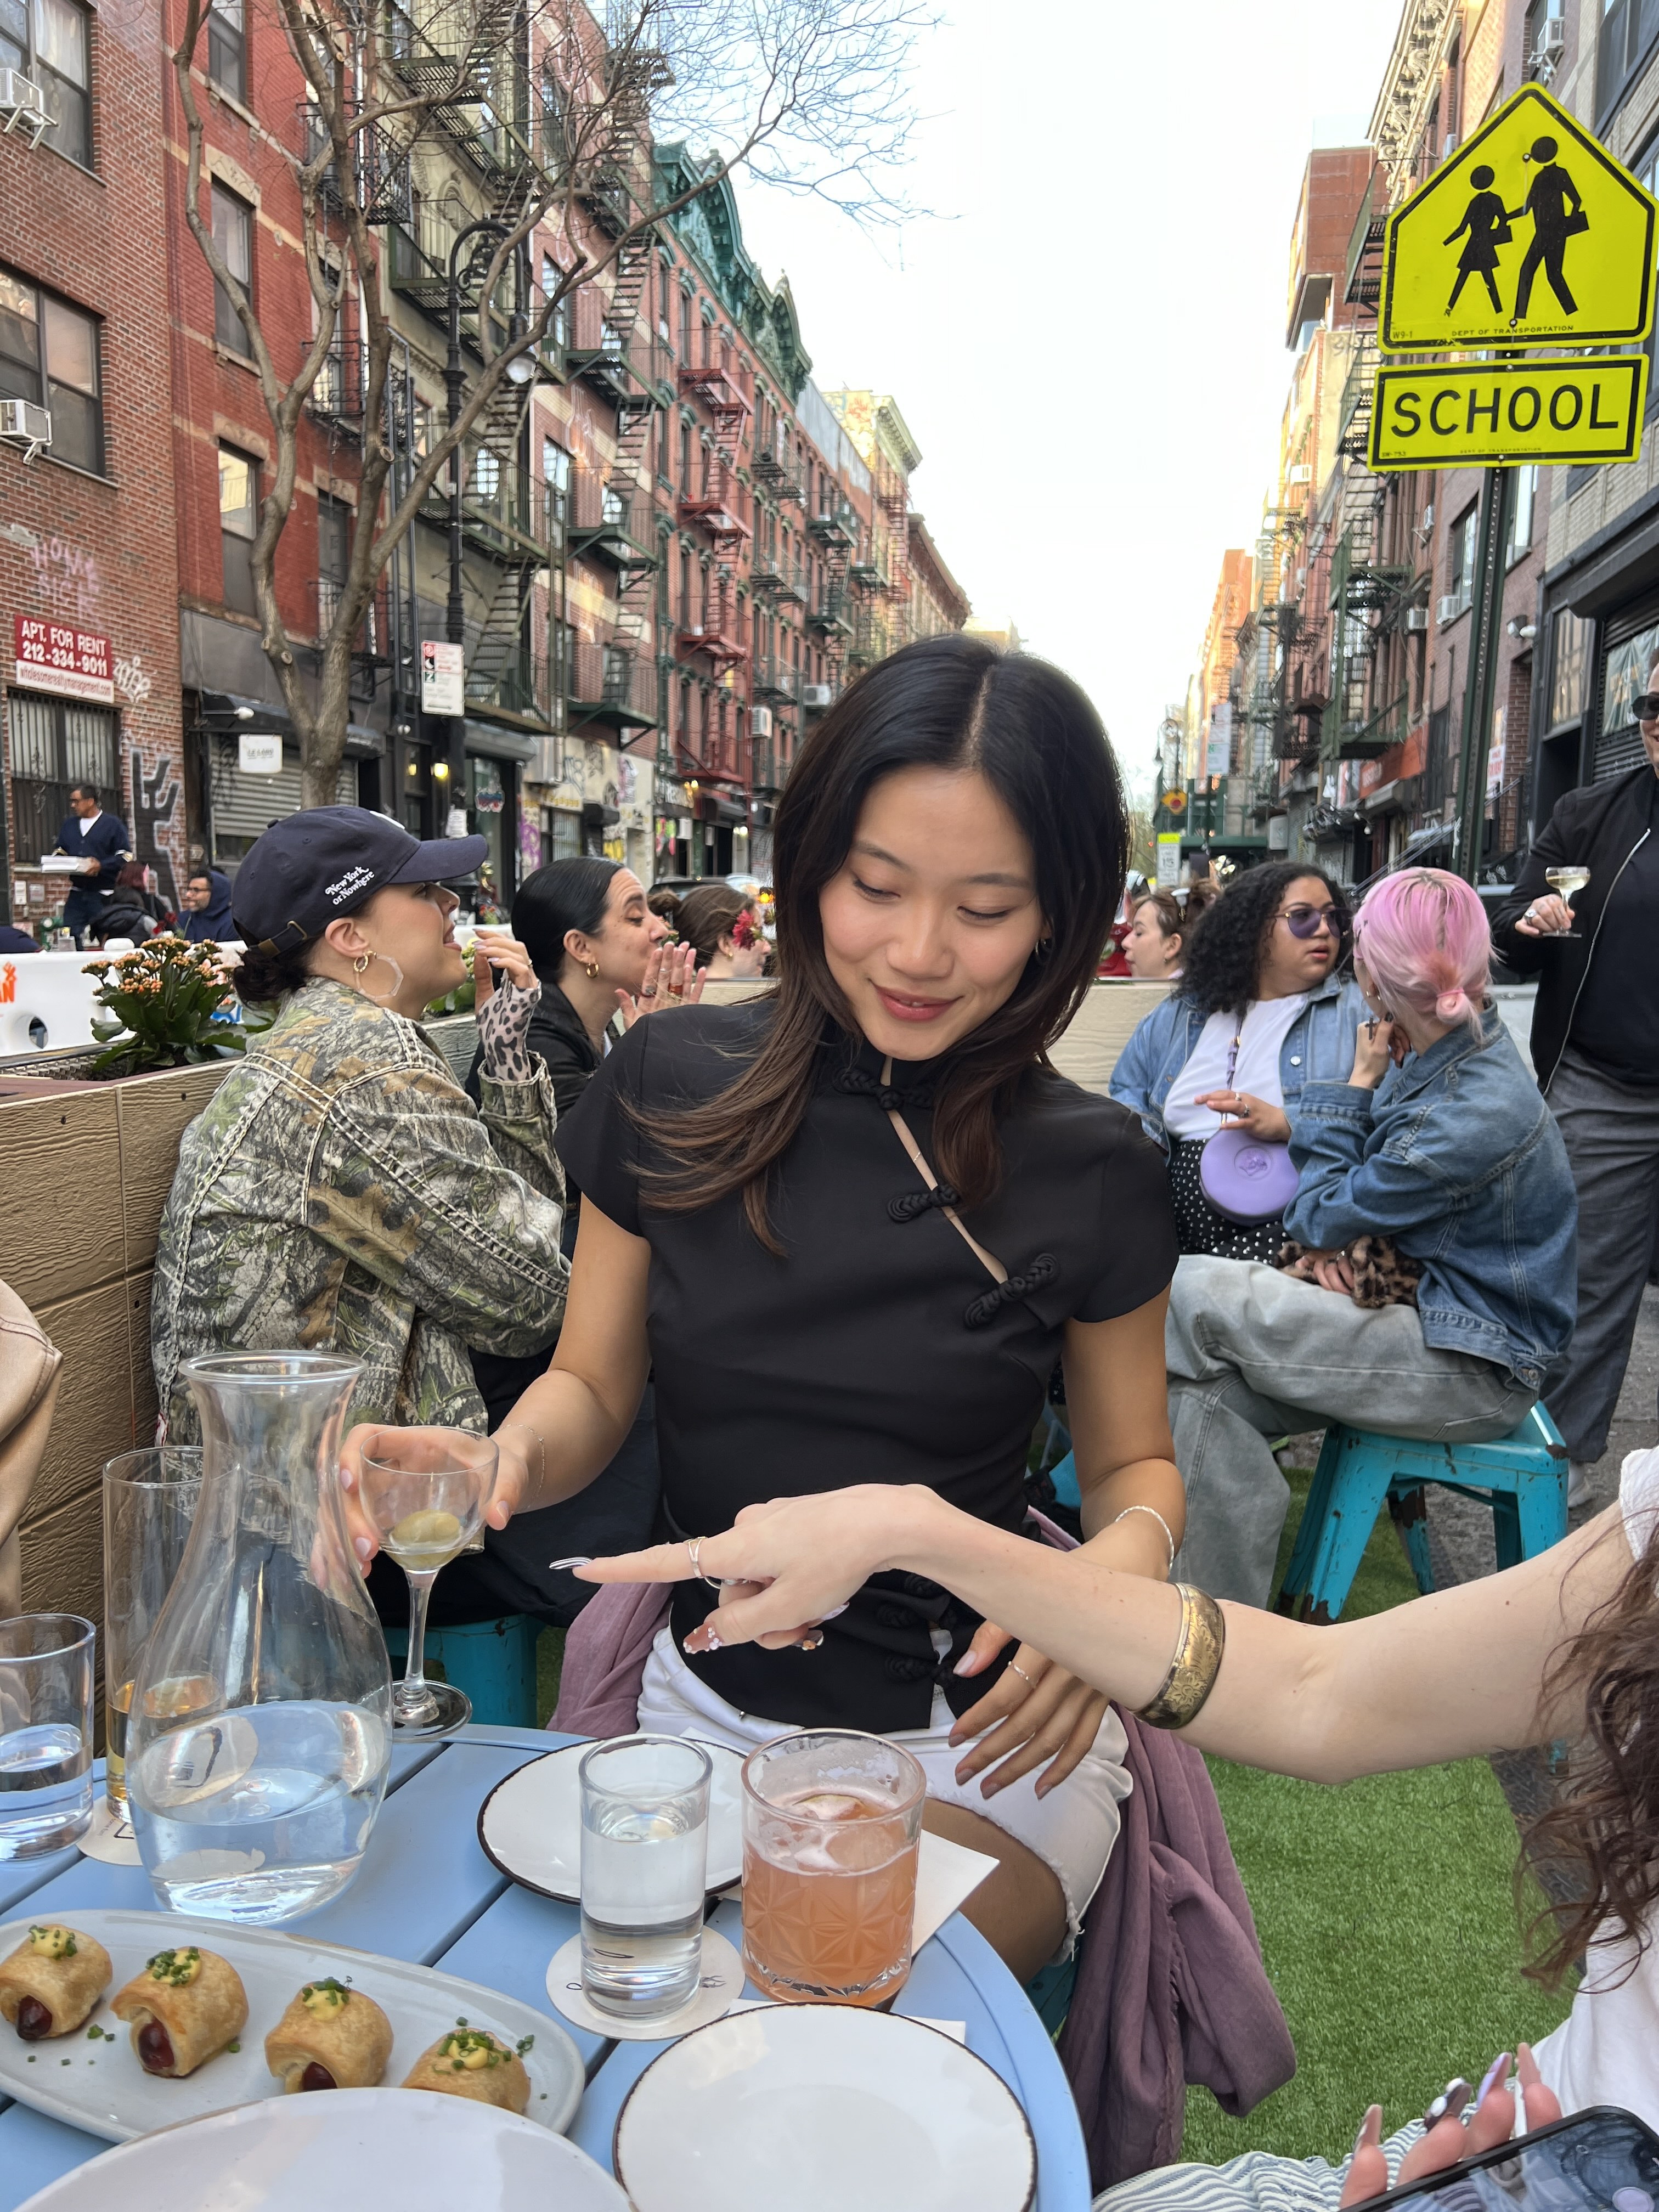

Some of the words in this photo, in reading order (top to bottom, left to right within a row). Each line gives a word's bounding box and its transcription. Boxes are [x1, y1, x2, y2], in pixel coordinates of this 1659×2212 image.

[1493, 326, 1573, 335] TRANSPORTATION
[1391, 385, 1618, 437] SCHOOL
[21, 619, 47, 643] APT.
[50, 627, 74, 650] FOR
[77, 634, 106, 657] RENT
[22, 640, 108, 677] 212-334-9011
[325, 879, 347, 895] New
[343, 866, 369, 882] York
[332, 895, 343, 905] or
[339, 871, 375, 899] Nowhere
